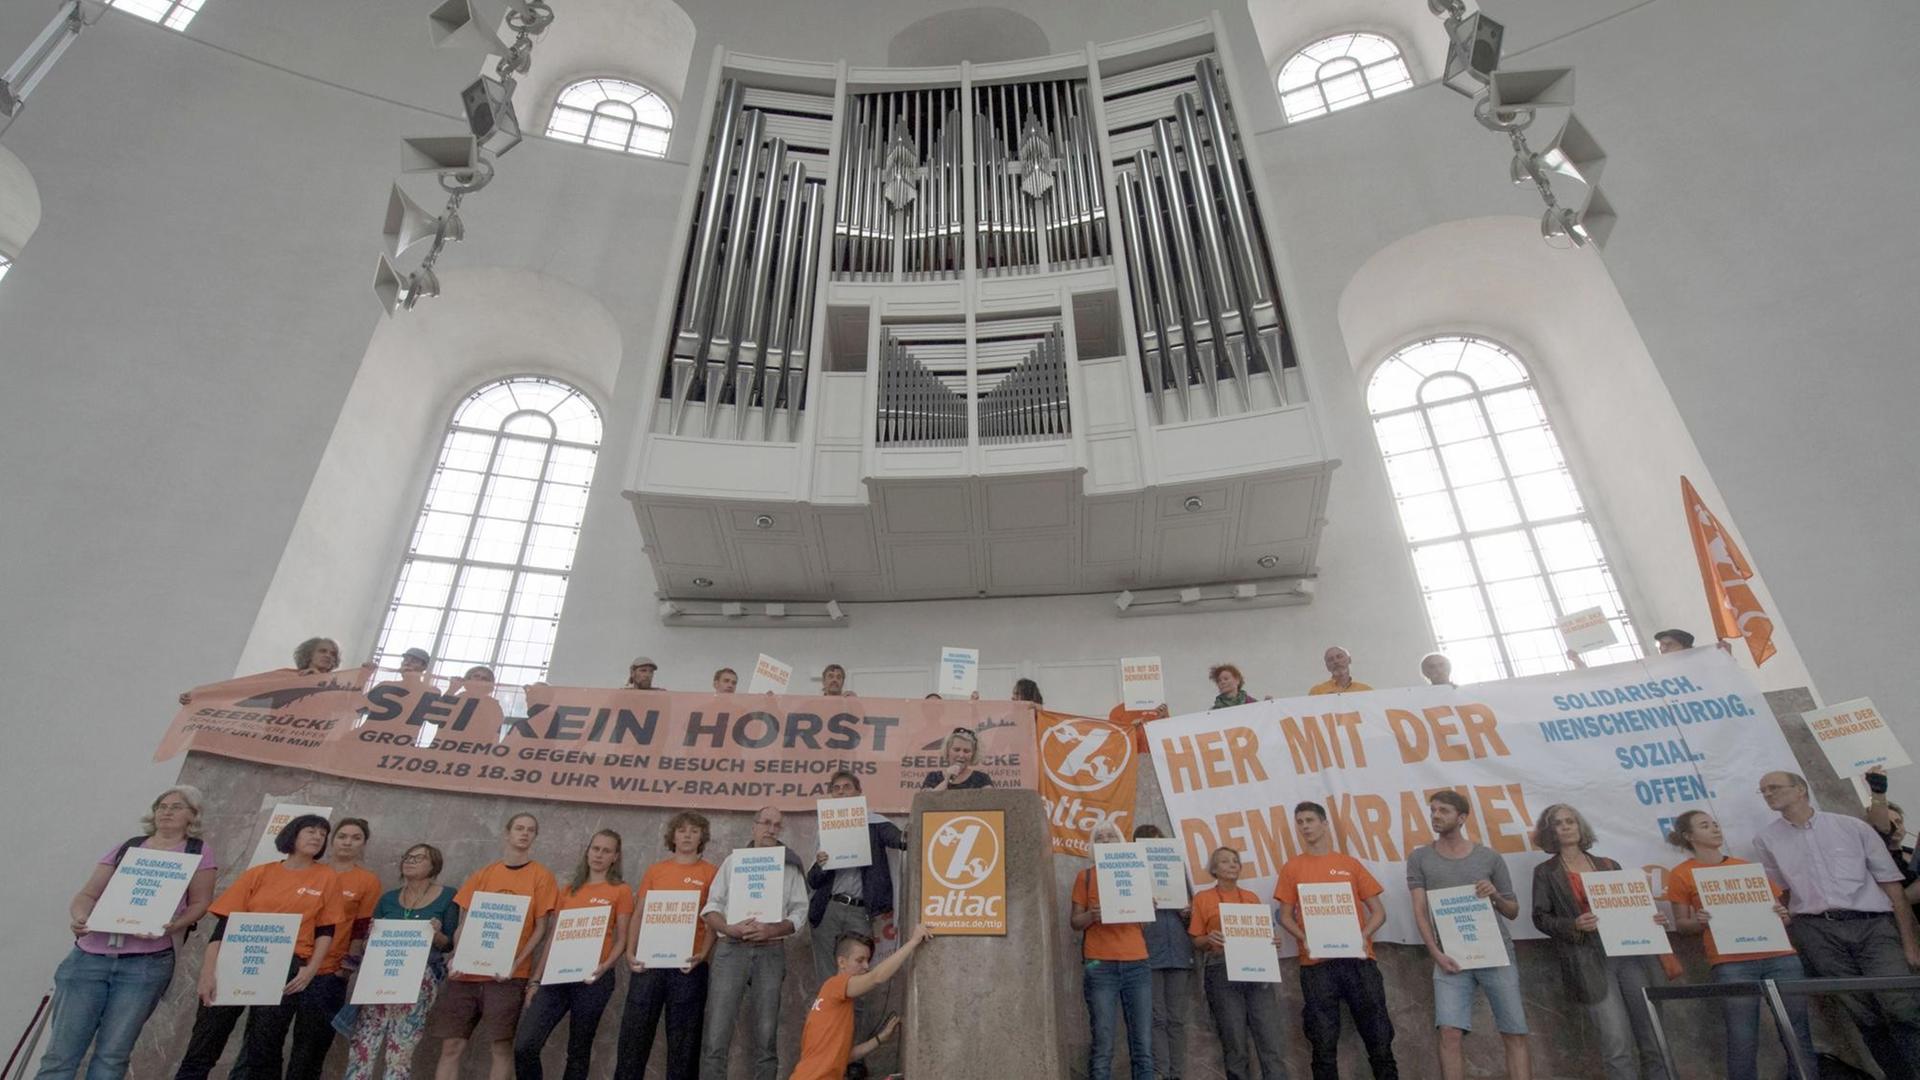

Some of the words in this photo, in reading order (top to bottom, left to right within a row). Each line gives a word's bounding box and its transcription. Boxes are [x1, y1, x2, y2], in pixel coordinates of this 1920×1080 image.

[1553, 675, 1703, 712] SOLIDARISCH.
[195, 708, 339, 731] SEEBRÜCKE
[355, 685, 480, 731] SEI
[497, 703, 659, 746] KEIN
[682, 711, 899, 751] HORST
[1538, 692, 1756, 743] MENSCHENWÜRDIG.
[1811, 718, 1832, 730] HER
[1834, 713, 1852, 725] MIT
[1854, 708, 1876, 720] DER
[262, 733, 285, 744] AM
[1162, 726, 1269, 793] HER
[1280, 711, 1367, 776] MIT
[1385, 703, 1511, 764] DER
[518, 747, 596, 765] GEGEN
[604, 753, 650, 769] DEN
[658, 755, 745, 773] BESUCH
[753, 759, 878, 775] SEEHOFERS
[901, 754, 1020, 768] SEEBCKE
[1615, 738, 1706, 770] SOZIAL.
[377, 754, 471, 776] 17.09.18
[477, 765, 542, 784] 18.30
[551, 773, 600, 788] UHR
[610, 776, 835, 797] WILLY-BRANDT-PLAT
[1635, 774, 1716, 806] OFFEN.
[1589, 884, 1607, 896] HER
[1609, 882, 1625, 894] MIT
[1628, 881, 1647, 893] DER
[1700, 880, 1720, 892] HER
[1724, 879, 1742, 891] MIT
[1744, 877, 1766, 889] DER
[925, 890, 1002, 917] attac
